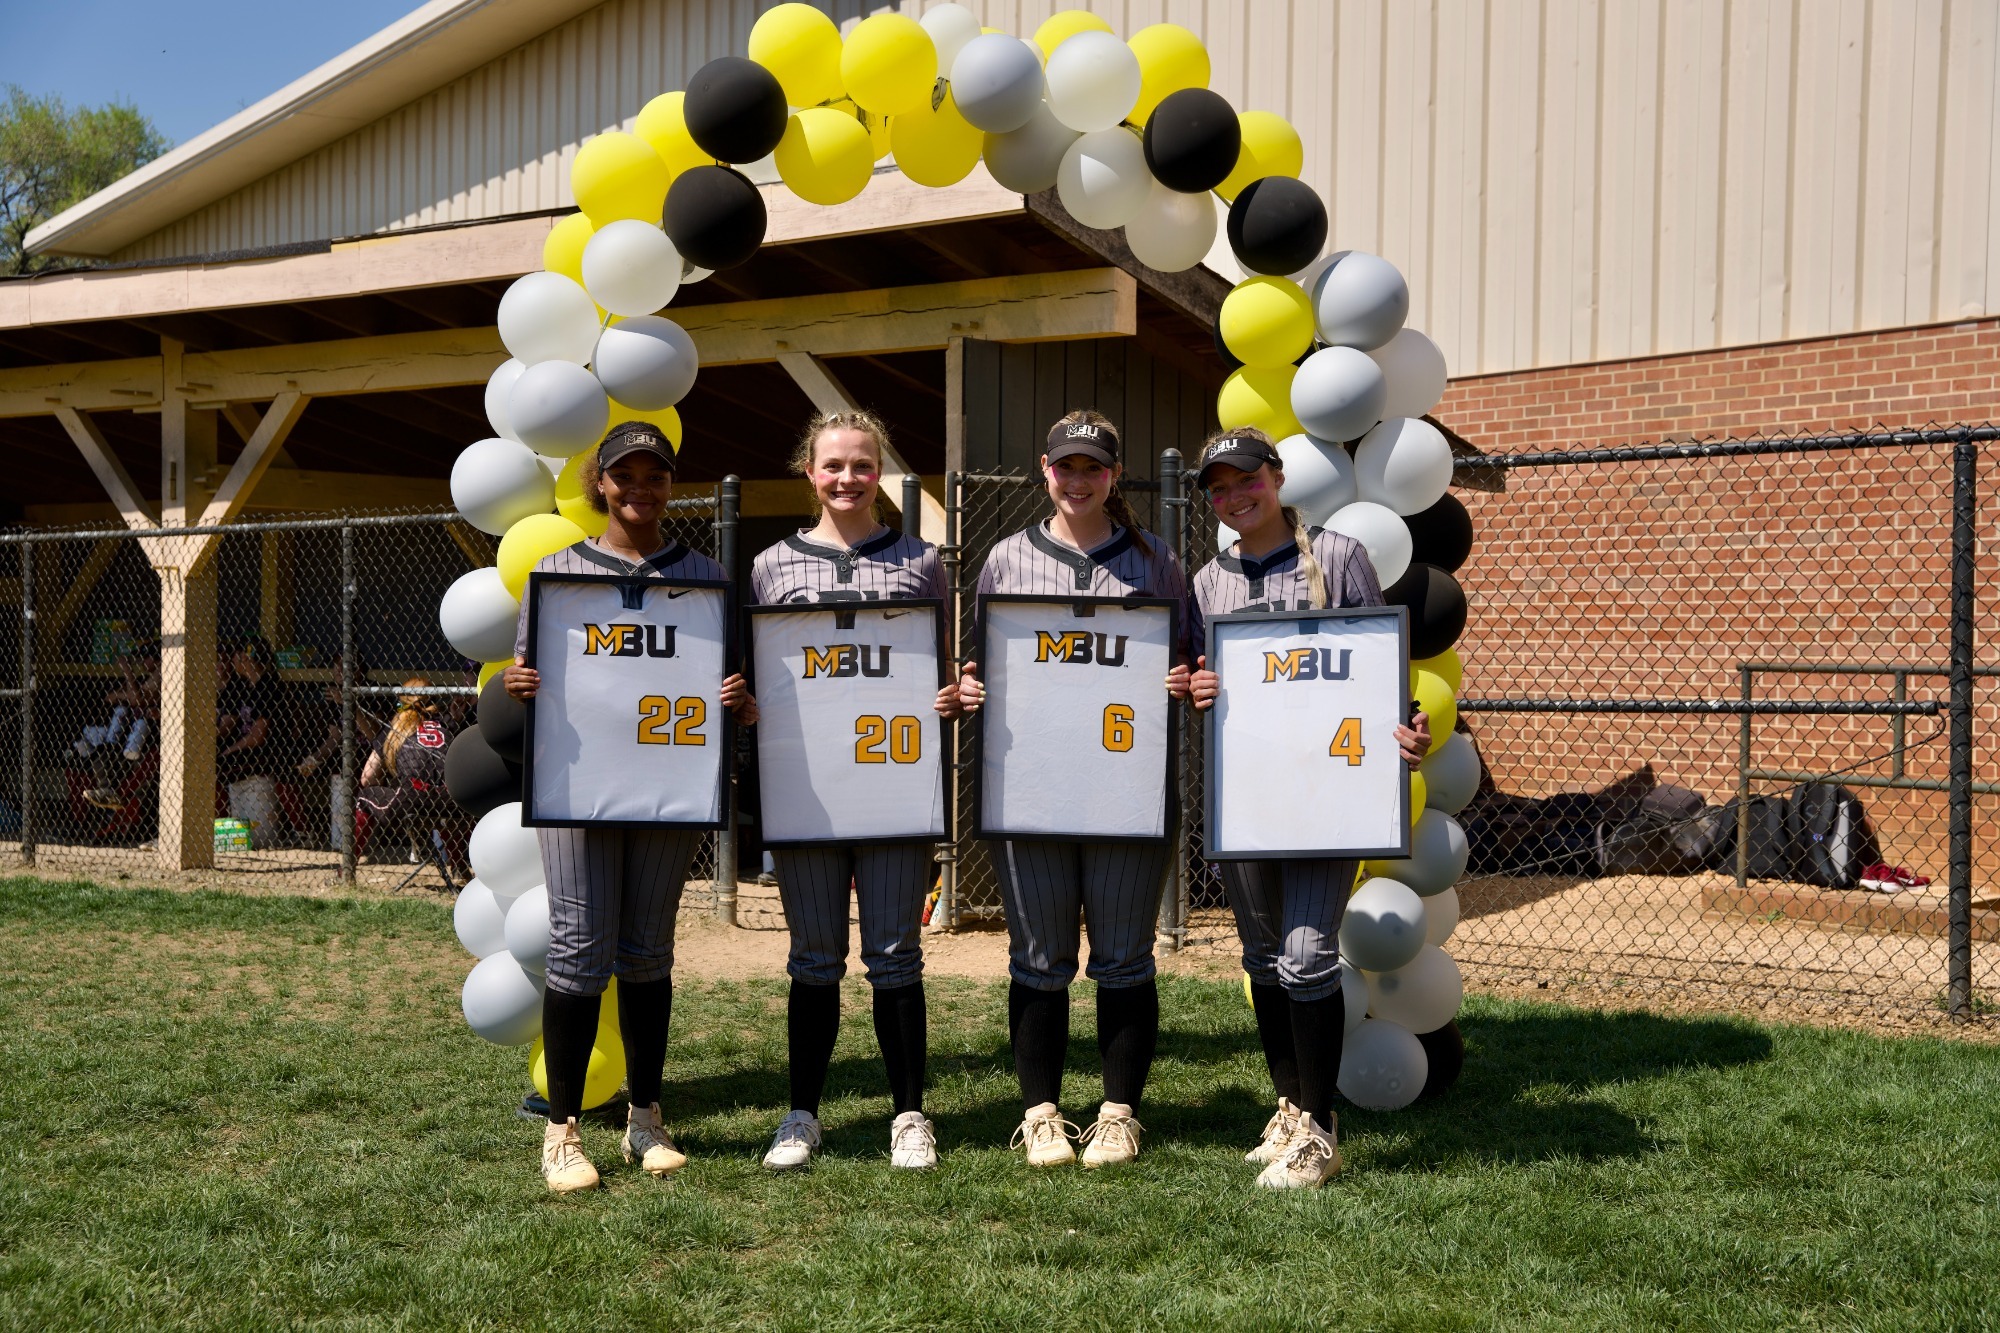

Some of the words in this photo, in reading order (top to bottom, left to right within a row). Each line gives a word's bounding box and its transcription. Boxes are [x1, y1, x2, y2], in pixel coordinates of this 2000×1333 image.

[624, 433, 657, 446] MBU
[1066, 425, 1099, 437] MBU
[582, 623, 678, 658] MBU
[1034, 631, 1129, 667] MBU
[801, 644, 892, 679] MBU
[1261, 648, 1354, 683] MBU
[637, 695, 706, 746] 22
[1102, 703, 1135, 753] 6
[855, 714, 921, 764] 20
[1329, 717, 1365, 766] 4
